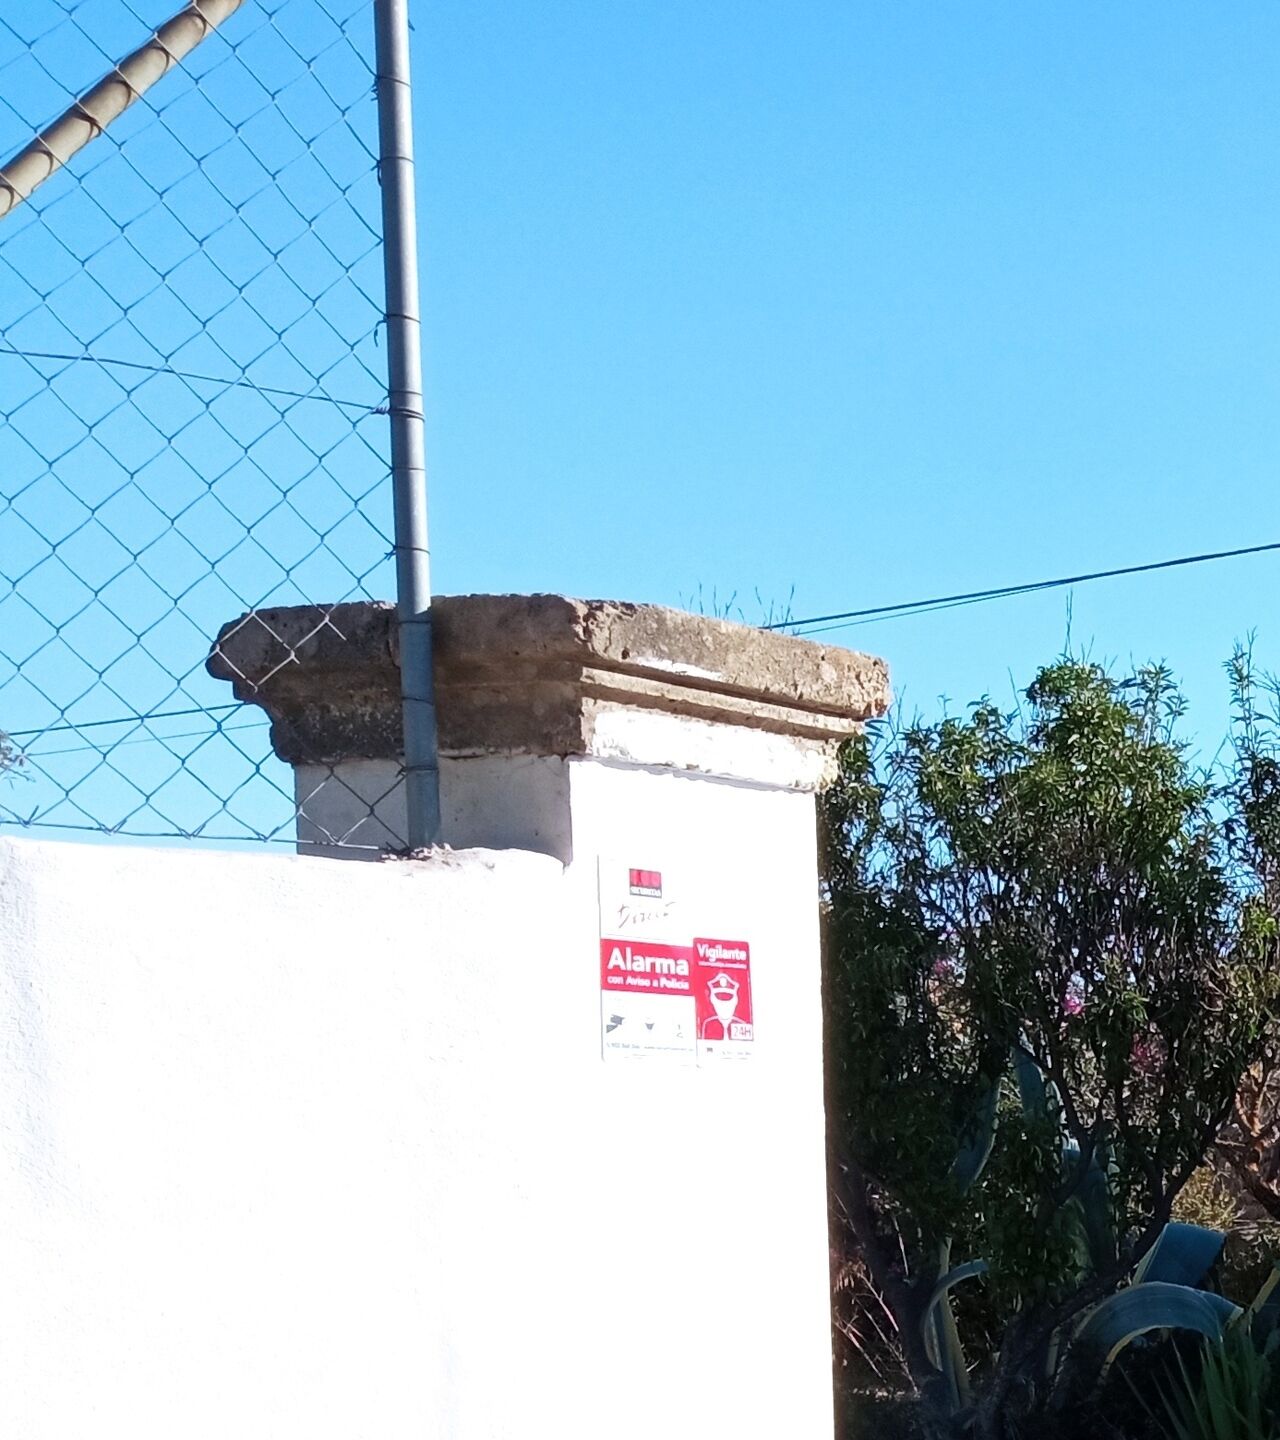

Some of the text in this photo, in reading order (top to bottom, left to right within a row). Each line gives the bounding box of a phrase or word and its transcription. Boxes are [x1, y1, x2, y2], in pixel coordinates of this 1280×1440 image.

[607, 946, 689, 976] Alarma
[696, 943, 747, 963] Vigilante
[607, 976, 624, 985] con
[625, 976, 651, 987] Aviso
[652, 978, 659, 988] a
[733, 1025, 752, 1038] 24H
